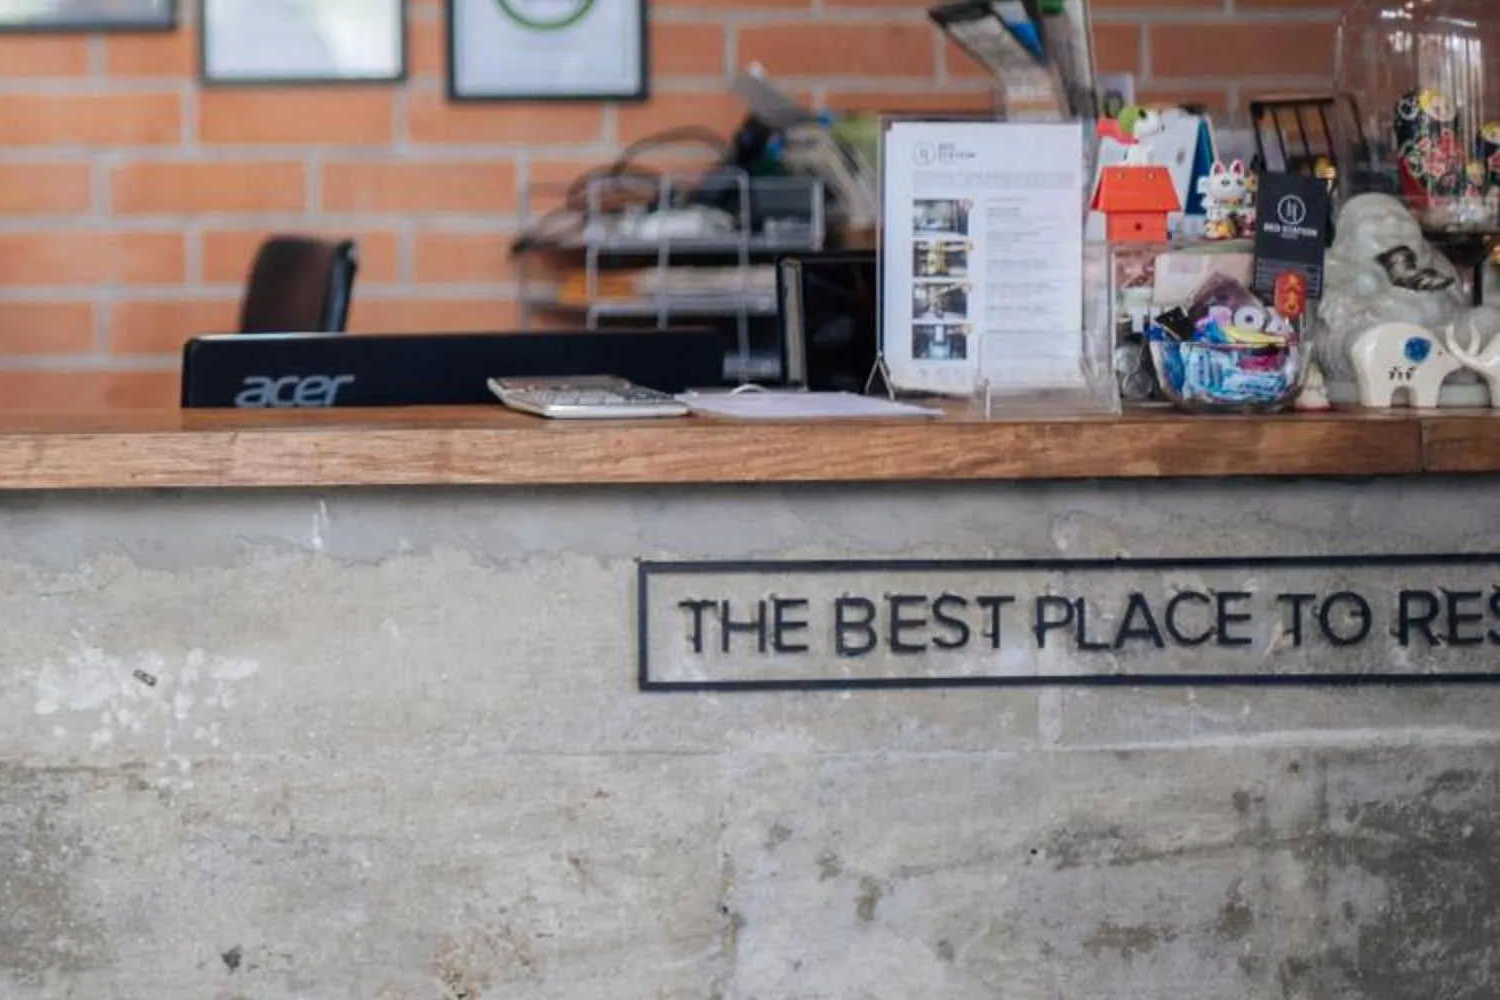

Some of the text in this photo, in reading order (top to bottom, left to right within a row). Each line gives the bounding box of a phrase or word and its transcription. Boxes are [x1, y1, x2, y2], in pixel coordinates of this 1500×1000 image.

[234, 374, 356, 406] acer
[678, 597, 808, 653] THE
[834, 592, 1015, 657] BEST
[1035, 590, 1253, 650] PLACE
[1276, 590, 1372, 647] TO
